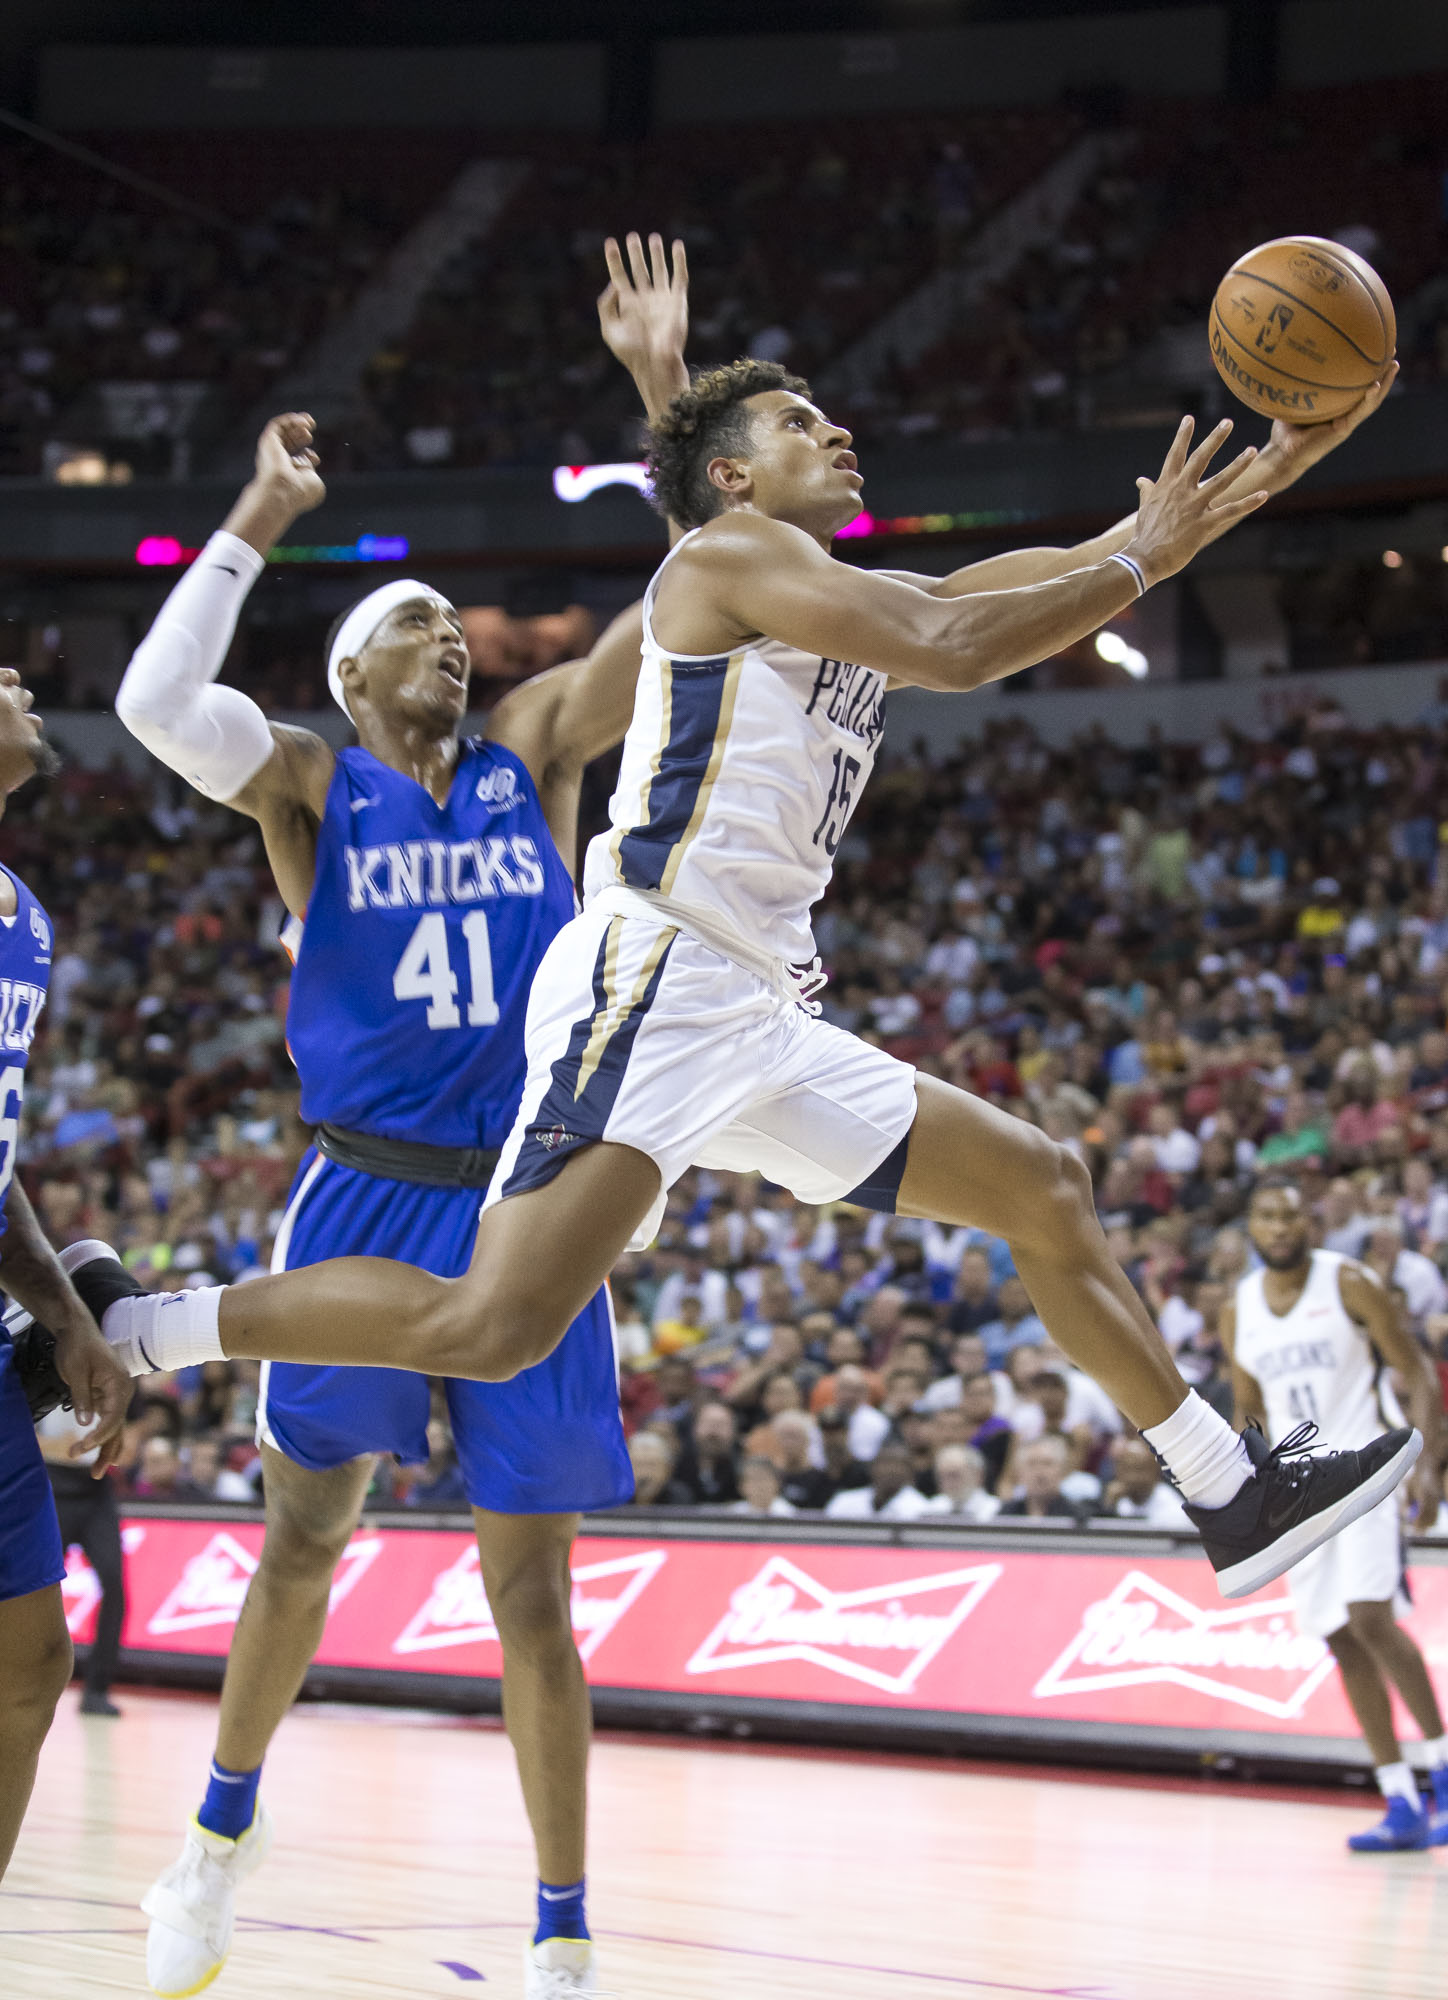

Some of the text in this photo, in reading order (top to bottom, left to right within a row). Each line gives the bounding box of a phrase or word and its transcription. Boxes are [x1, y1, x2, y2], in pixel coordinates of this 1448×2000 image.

[1212, 325, 1319, 411] SPALDING
[812, 748, 861, 857] 15
[344, 832, 545, 913] KNICKS
[392, 909, 500, 1031] 41
